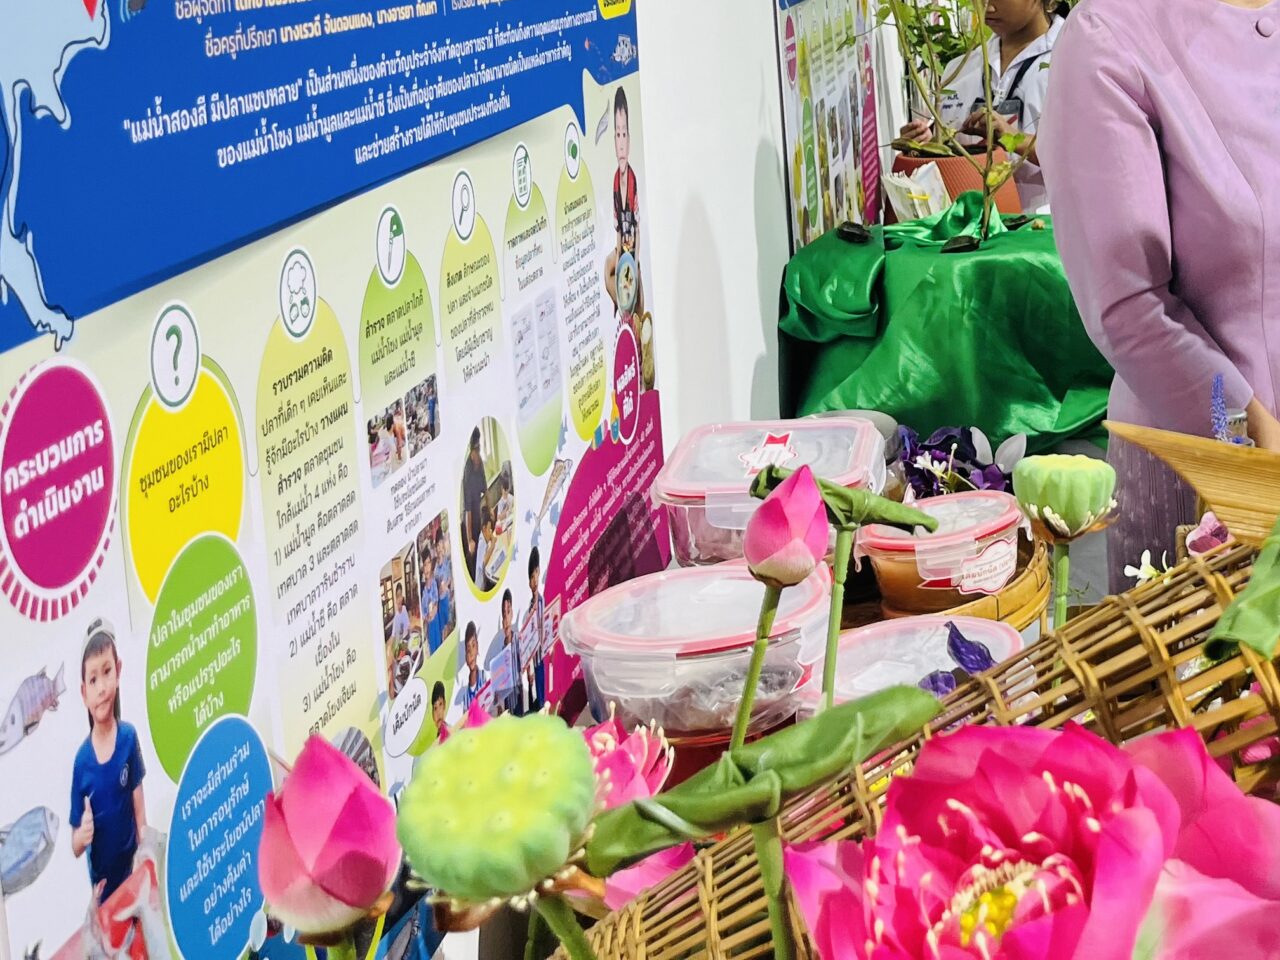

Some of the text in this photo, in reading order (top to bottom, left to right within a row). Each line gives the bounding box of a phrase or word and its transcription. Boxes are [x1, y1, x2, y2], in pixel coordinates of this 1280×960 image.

[204, 22, 278, 60] ชื่อครูที่ปรึกษา
[280, 15, 322, 43] นางเรวดี
[123, 95, 208, 144] "แม่น้ำสองสี
[210, 78, 303, 123] มีปลาแซบหลาย"
[217, 117, 292, 168] ของแม่น้ำโขง
[295, 87, 386, 144] แม่น้ำมูลและแม่น้ำชี
[365, 314, 385, 339] สำรวจ
[272, 346, 333, 396] รวบรวมความคิด
[261, 398, 298, 437] ปลาที่เด็ก
[265, 401, 348, 474] รู้จักมีอะไรบ้าง วางแผน
[4, 419, 105, 494] กระบวนการ
[139, 425, 229, 498] ชุมชนของเรามีปลา
[277, 468, 301, 495] สำรวจ
[13, 465, 104, 539] ดำเนินงาน
[168, 474, 209, 513] อะไรบ้าง
[313, 485, 320, 500] 4
[273, 550, 282, 566] 1)
[307, 559, 315, 574] 3
[152, 565, 244, 649] ปลาในชุมชนของเรา
[150, 594, 251, 691] สามารถนำมาทำอาหาร
[288, 642, 297, 658] 2)
[168, 639, 241, 715] หรือแปรรูปอะไร
[302, 697, 310, 713] 3)
[193, 691, 225, 728] ได้บ้าง
[181, 741, 250, 820] เราจะมีส่วนร่วม
[188, 772, 250, 851] ในการอนุรักษ์
[180, 799, 265, 903] และใช้ประโยชน์ปลา
[204, 851, 251, 914] อย่างคุ้มค่า
[208, 888, 252, 946] ได้อย่างไร
